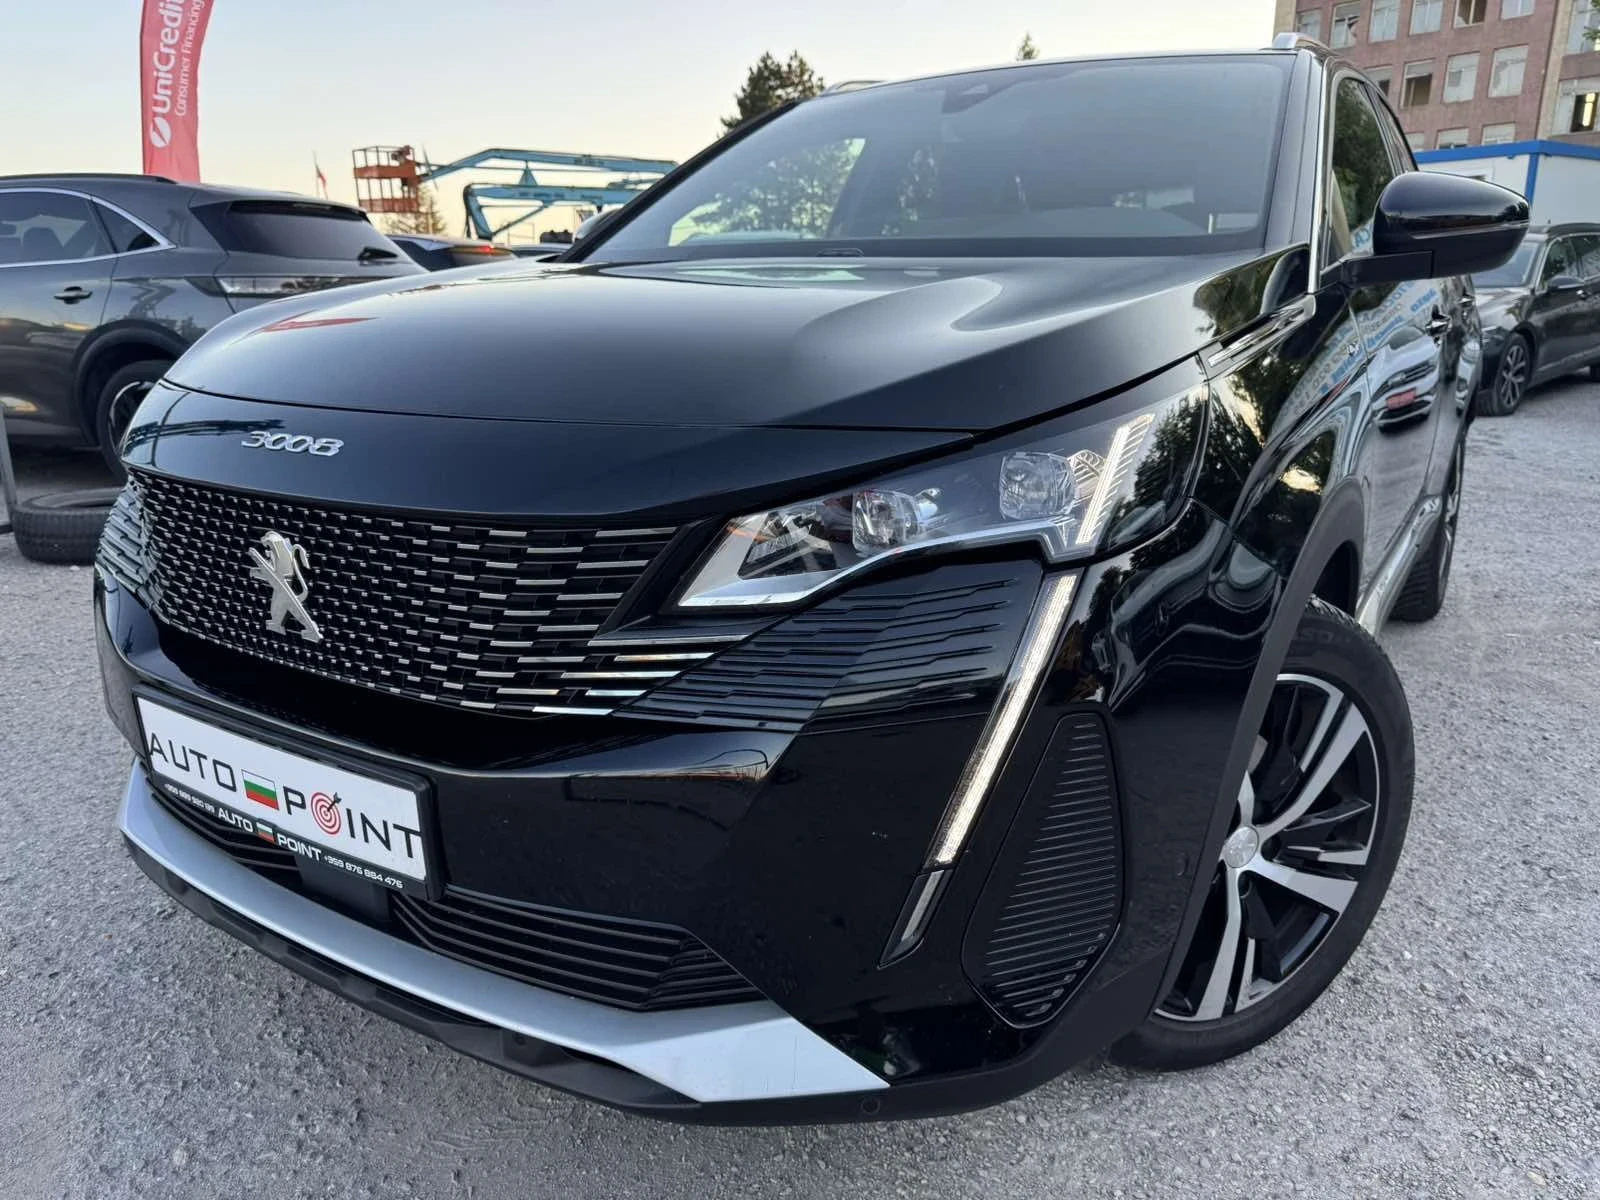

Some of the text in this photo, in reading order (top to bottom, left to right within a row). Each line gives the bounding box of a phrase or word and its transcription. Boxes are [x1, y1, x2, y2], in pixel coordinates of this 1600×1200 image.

[175, 0, 205, 116] Consumer Financing
[241, 430, 345, 456] 3008
[149, 732, 238, 792] AUTO
[218, 807, 254, 833] AUTO
[276, 832, 322, 861] POINT
